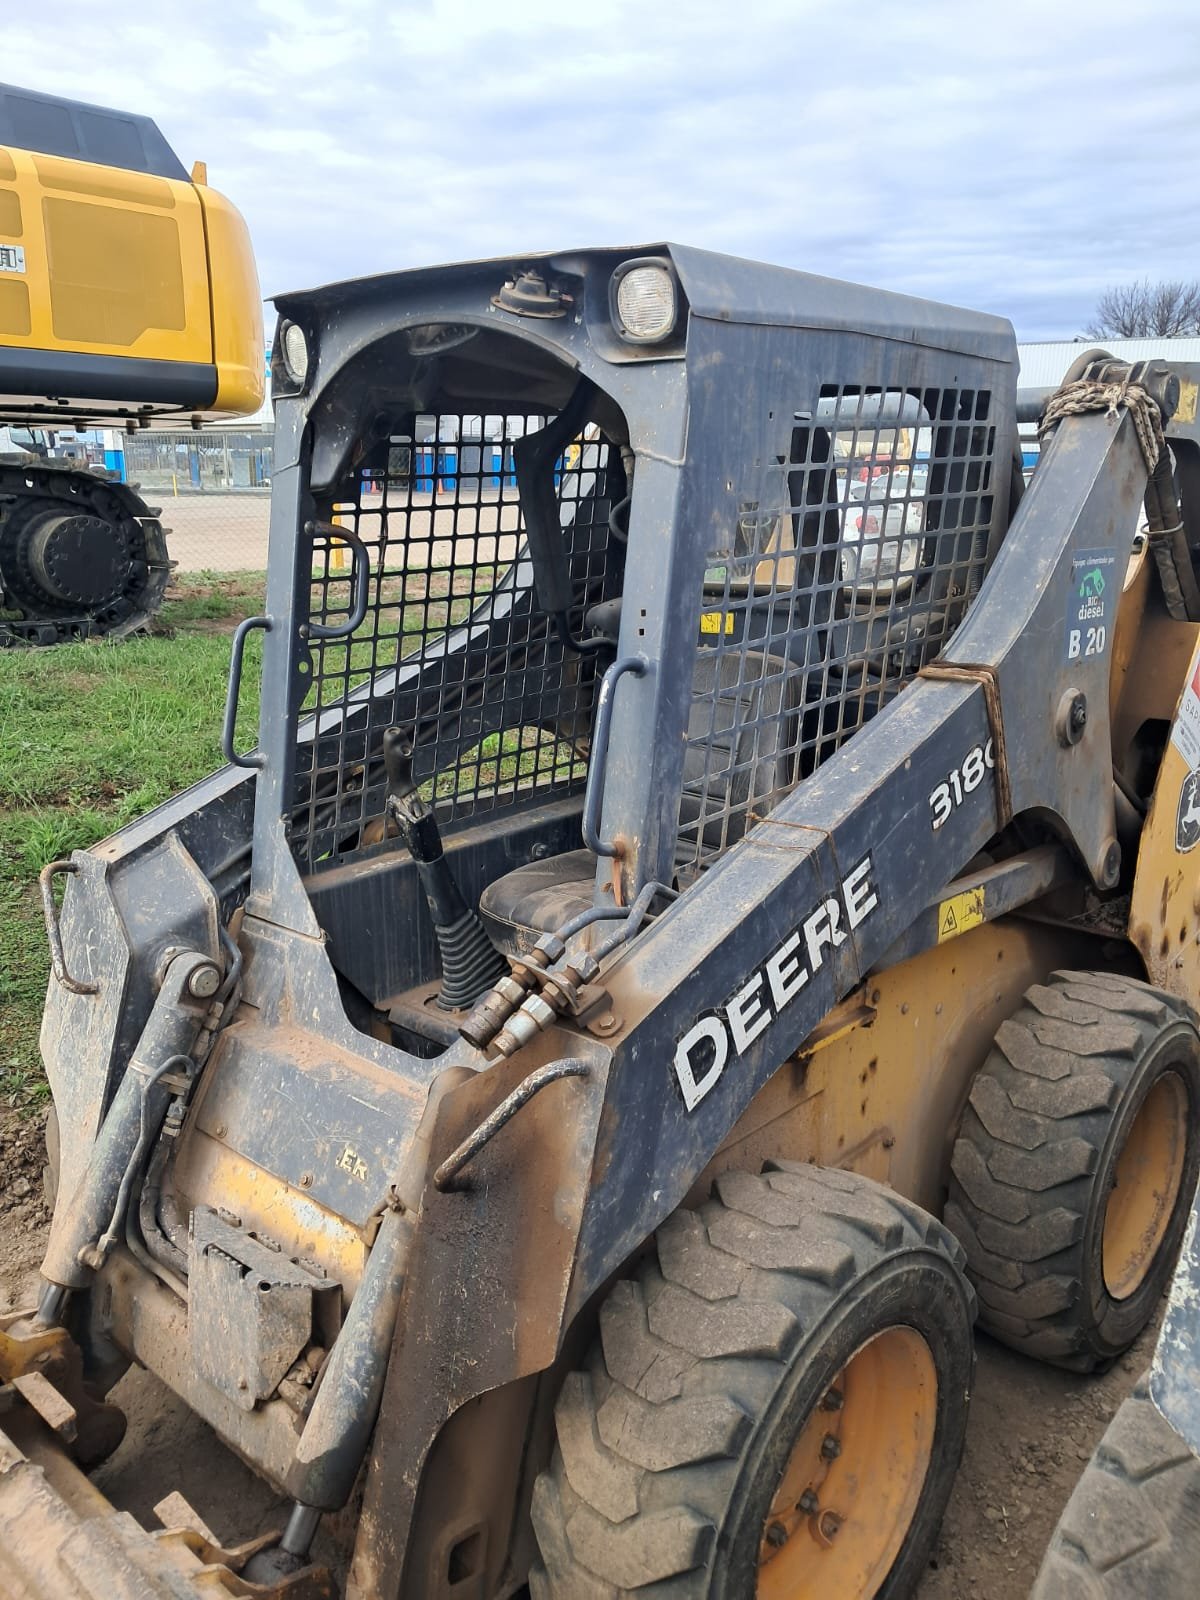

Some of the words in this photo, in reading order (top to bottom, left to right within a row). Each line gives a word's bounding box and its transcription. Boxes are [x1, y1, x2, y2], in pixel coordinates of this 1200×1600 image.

[1078, 601, 1104, 620] diesel
[1068, 629, 1081, 659] B
[1085, 626, 1106, 656] 20
[674, 857, 878, 1112] DEERE
